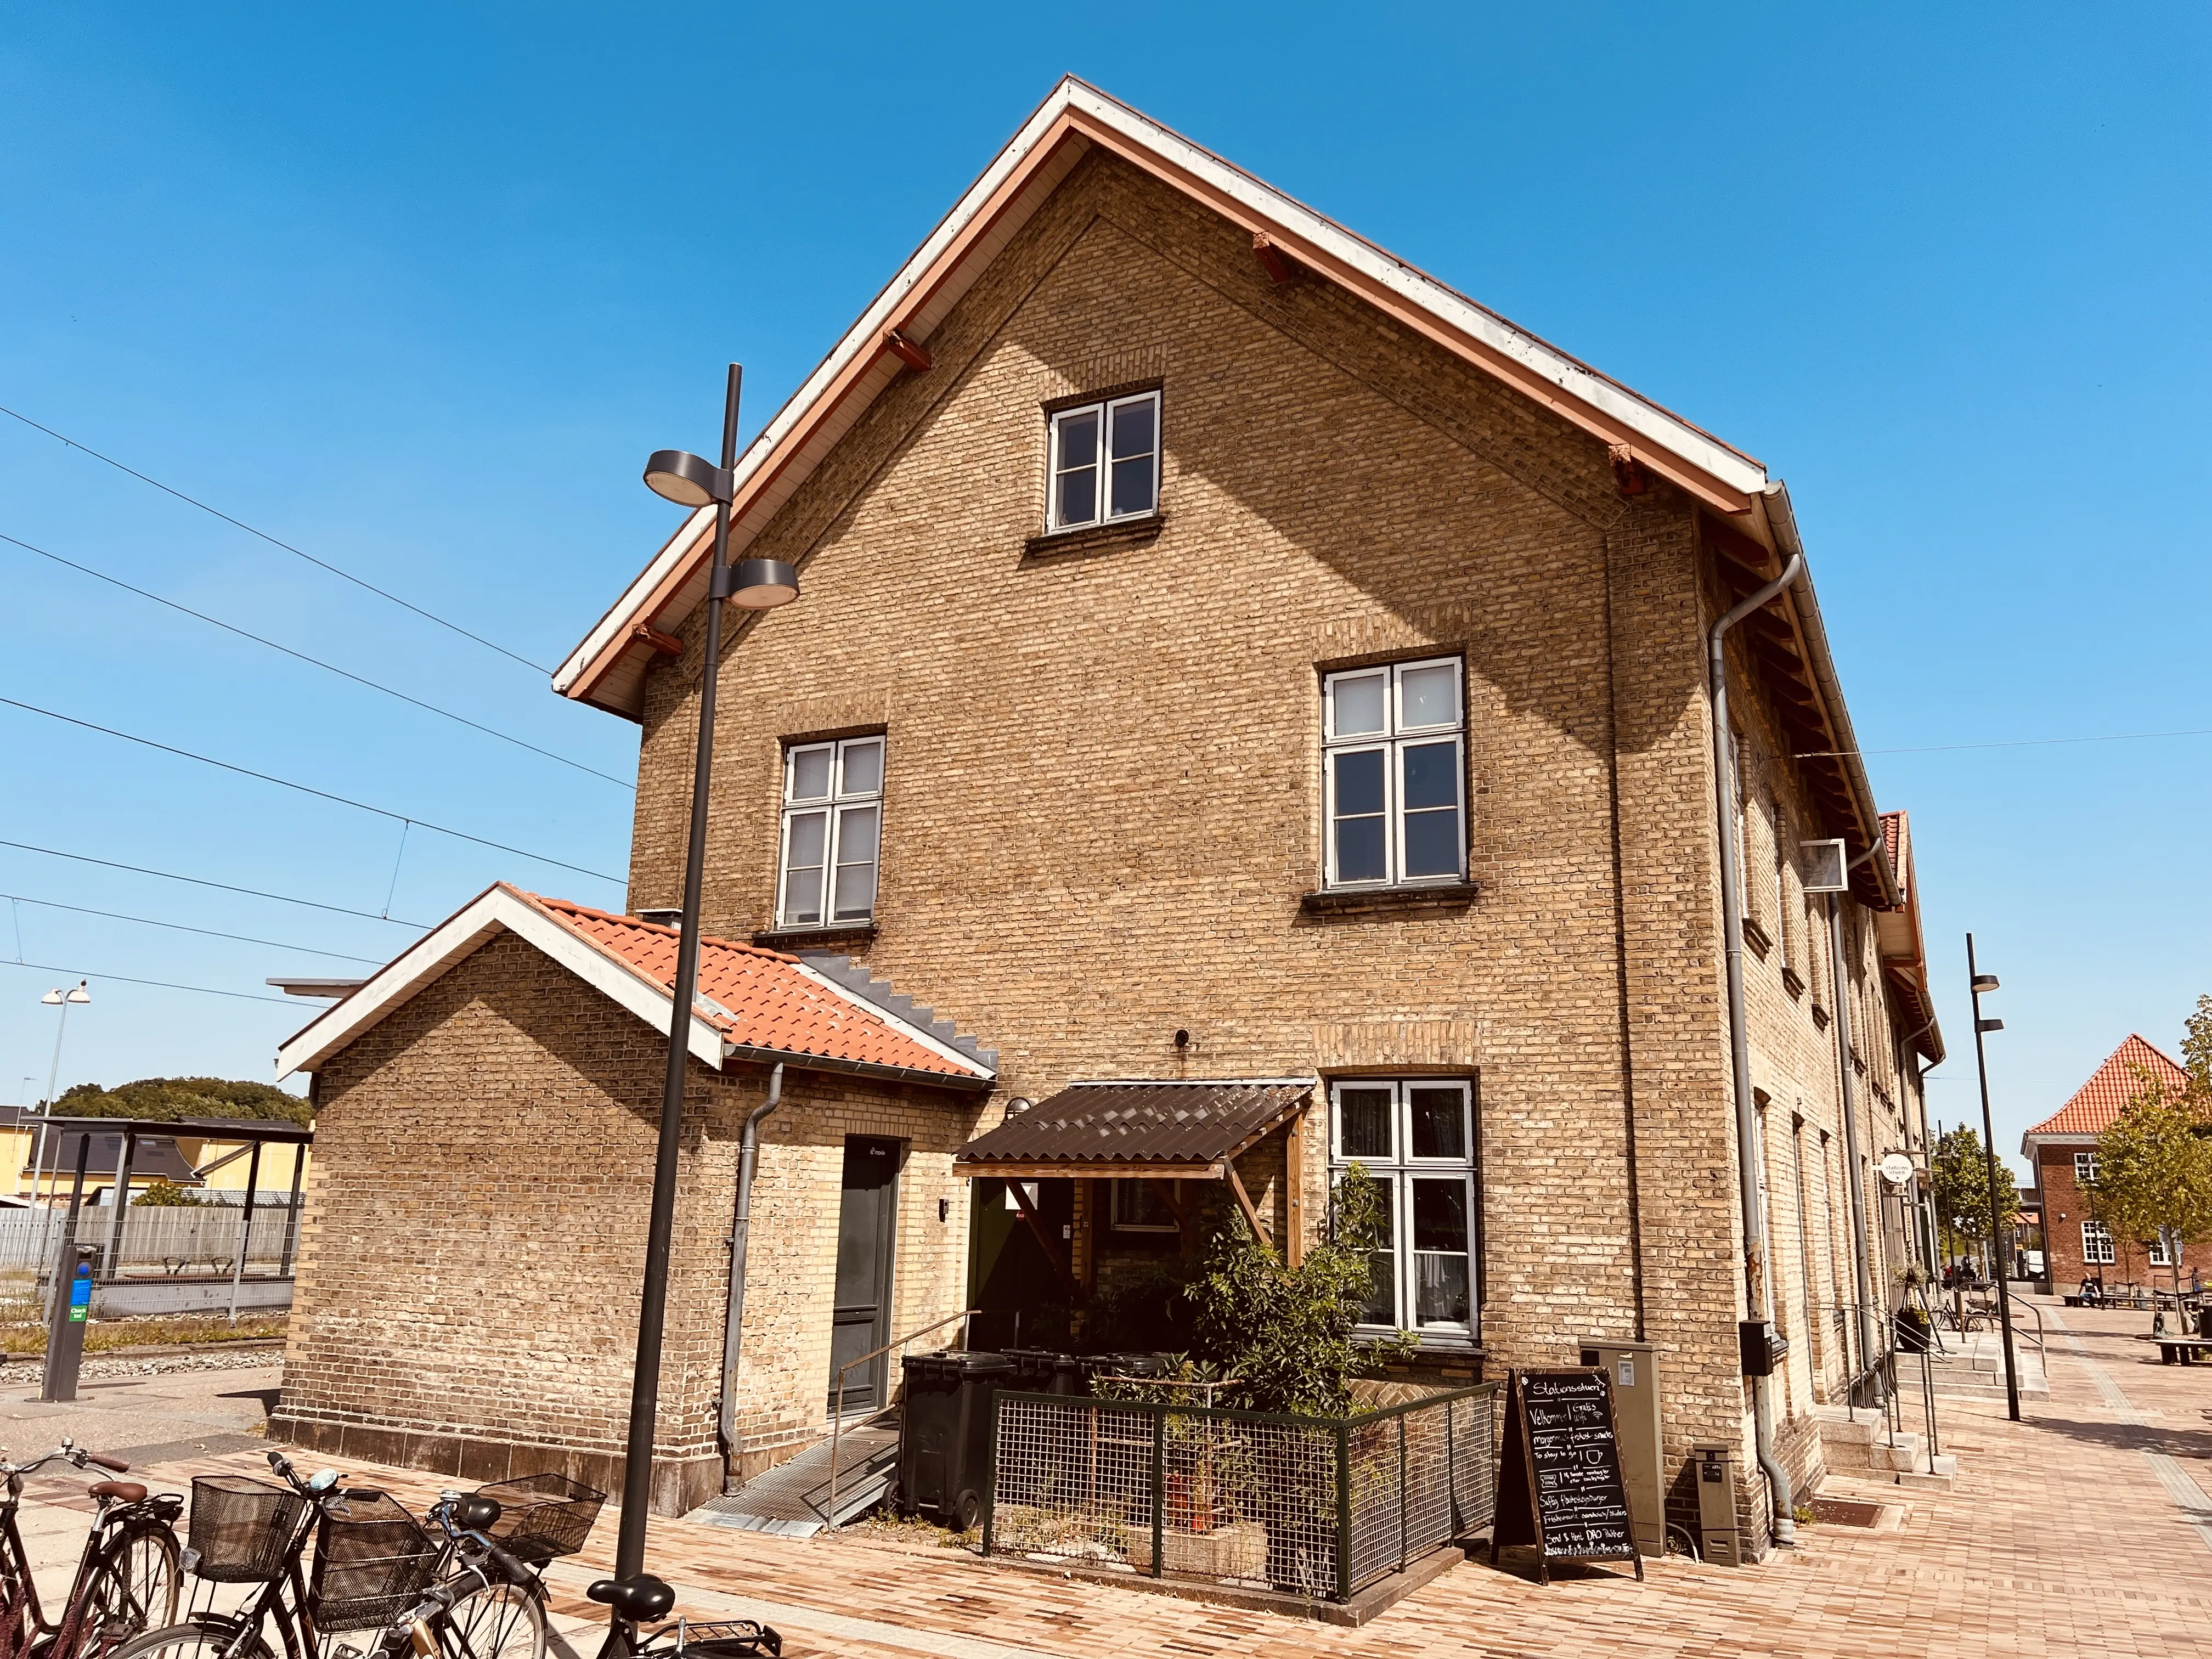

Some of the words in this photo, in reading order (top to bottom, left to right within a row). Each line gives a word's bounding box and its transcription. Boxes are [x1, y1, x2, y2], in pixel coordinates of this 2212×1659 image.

[1533, 1382, 1600, 1395] Stationsstuen
[1573, 1402, 1596, 1412] Gratis
[1530, 1408, 1567, 1425] Velkommen
[1544, 1451, 1558, 1463] stay
[1568, 1452, 1577, 1460] go
[1546, 1533, 1561, 1545] Send
[1585, 1529, 1602, 1541] DAO
